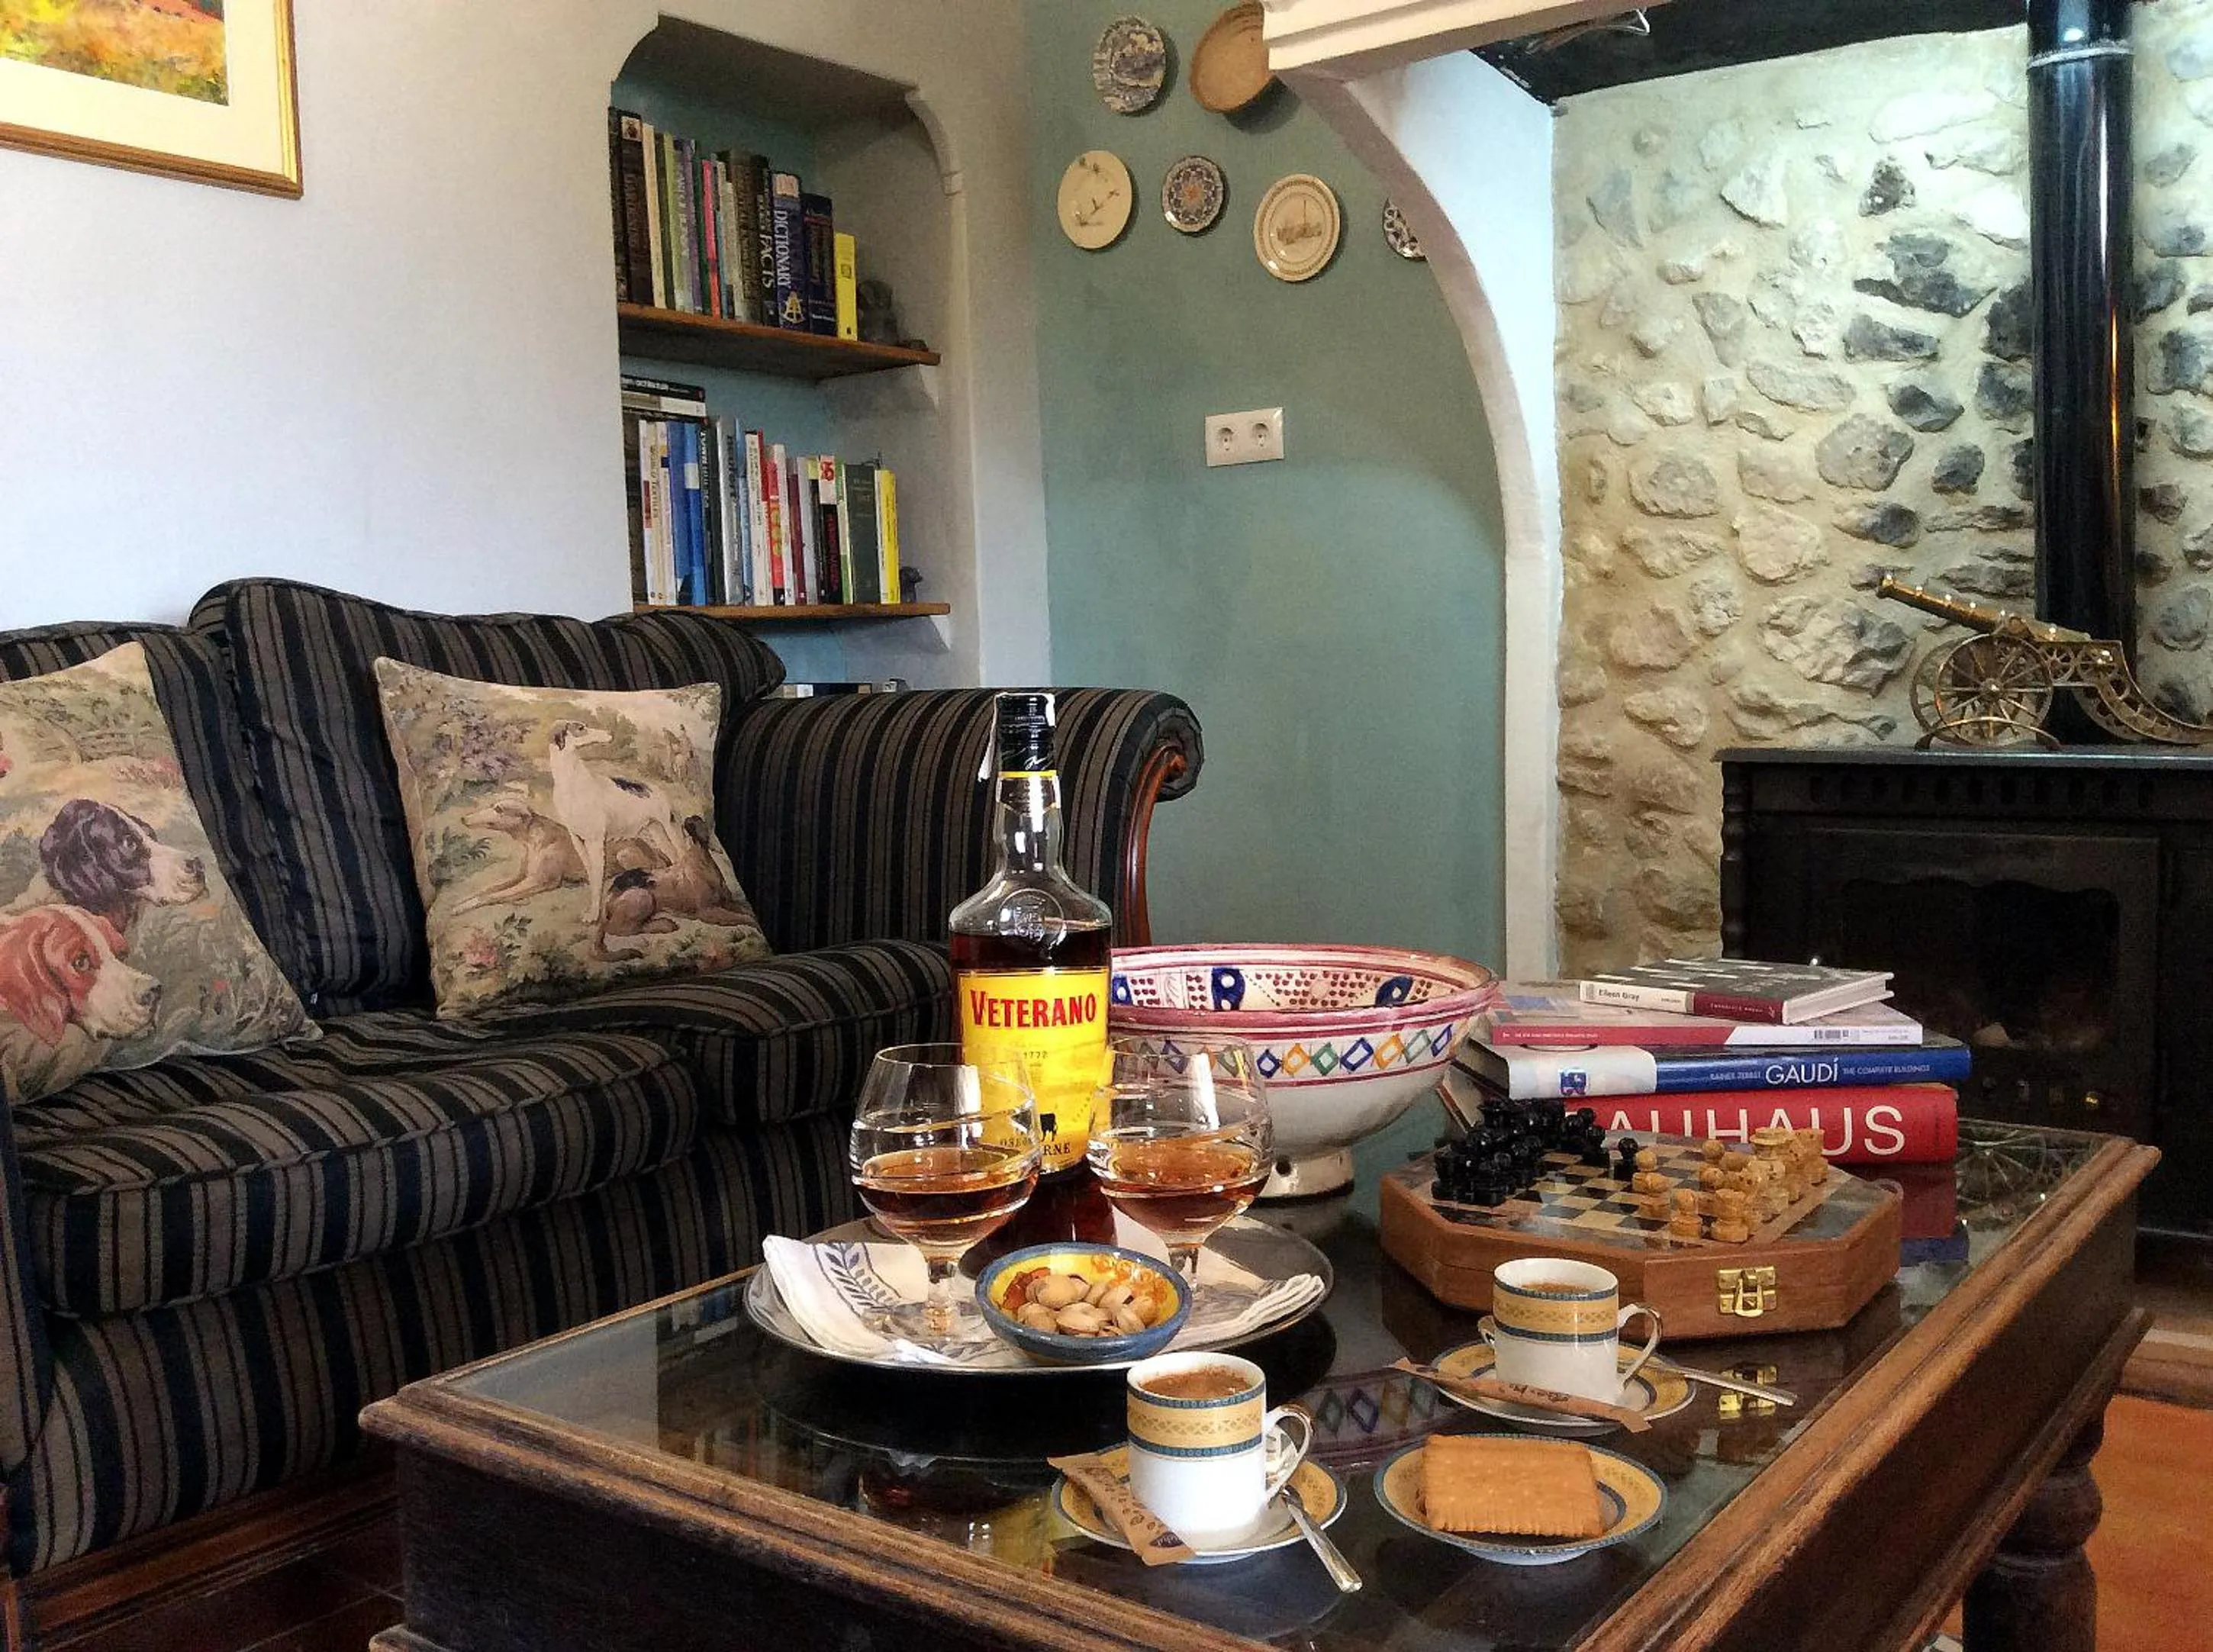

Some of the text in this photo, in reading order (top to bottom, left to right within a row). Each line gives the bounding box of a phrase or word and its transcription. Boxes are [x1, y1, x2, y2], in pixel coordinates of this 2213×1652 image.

[759, 233, 775, 288] FACTS
[774, 210, 791, 288] DICTIONARY
[971, 990, 1097, 1027] VETERANO
[1598, 988, 1640, 1002] Eileen Gray
[1023, 1050, 1049, 1060] 1772
[1765, 1058, 1839, 1084] GAUDÍ
